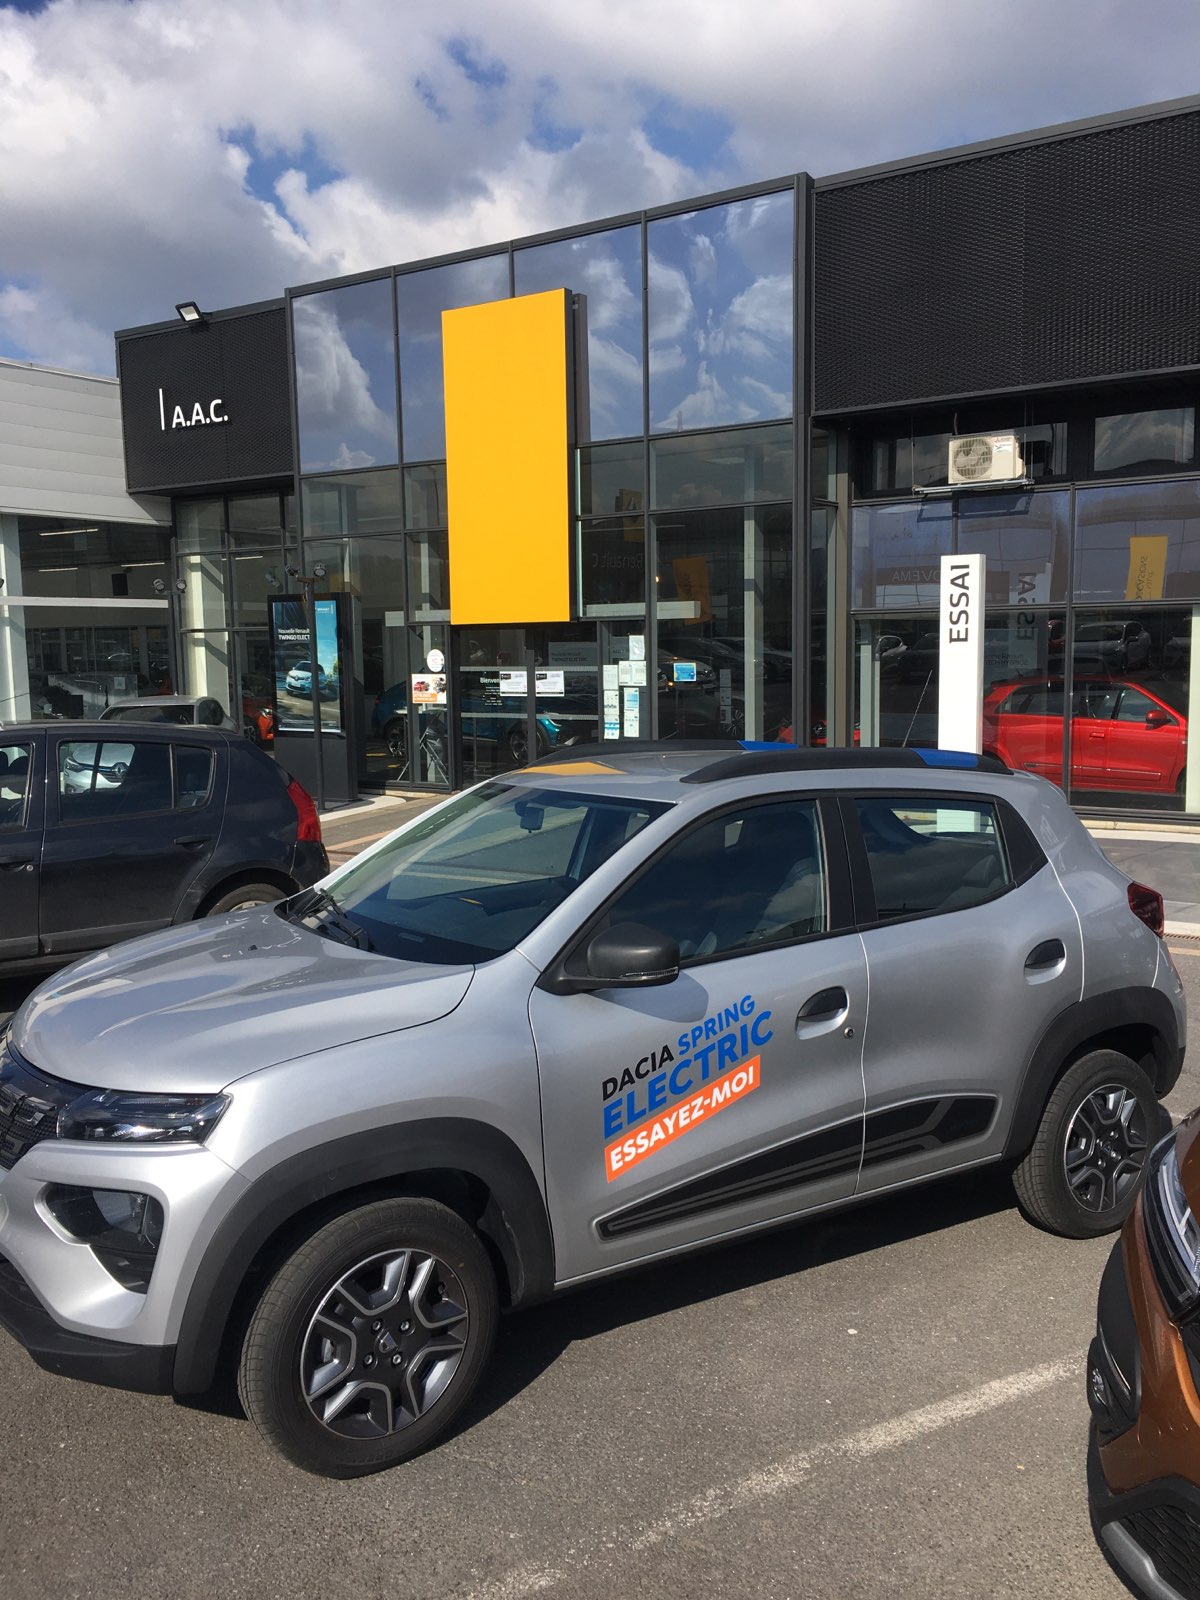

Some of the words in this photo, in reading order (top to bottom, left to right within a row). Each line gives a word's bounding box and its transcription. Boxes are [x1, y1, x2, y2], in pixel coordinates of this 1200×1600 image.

[948, 564, 971, 644] ESSAI
[602, 1044, 674, 1101] DACIA
[677, 994, 755, 1056] SPRING
[603, 1010, 774, 1140] ELECTRIC
[609, 1065, 755, 1172] ESSAYEZ-MOI
